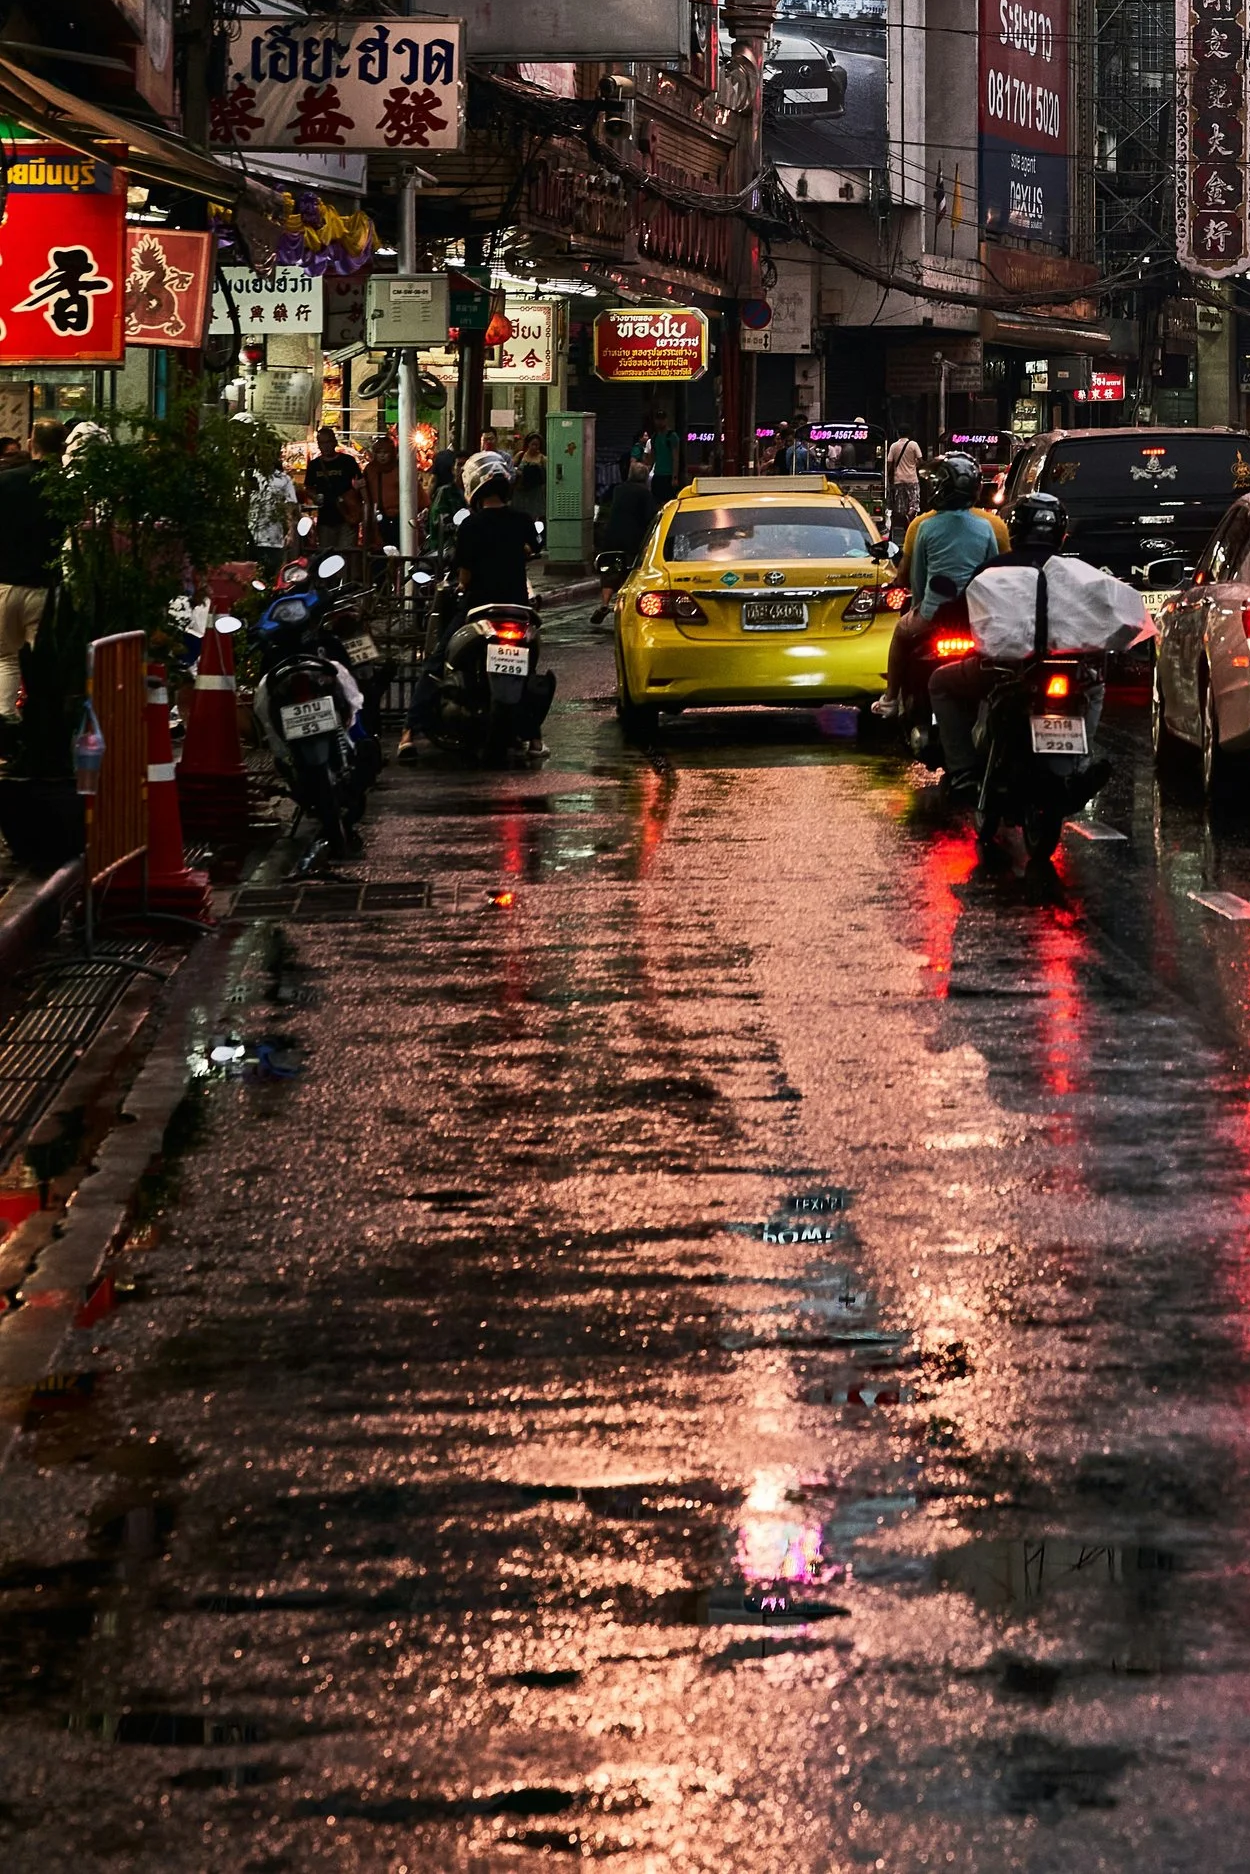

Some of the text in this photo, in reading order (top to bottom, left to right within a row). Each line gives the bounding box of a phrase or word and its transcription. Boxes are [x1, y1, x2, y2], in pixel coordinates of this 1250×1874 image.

[1036, 86, 1060, 139] 5020
[1009, 180, 1044, 220] nexus
[10, 244, 115, 338] 香
[617, 312, 687, 338] ทองใบ
[656, 335, 699, 347] เยาวราช
[494, 663, 522, 675] 7289
[1046, 741, 1074, 751] 229
